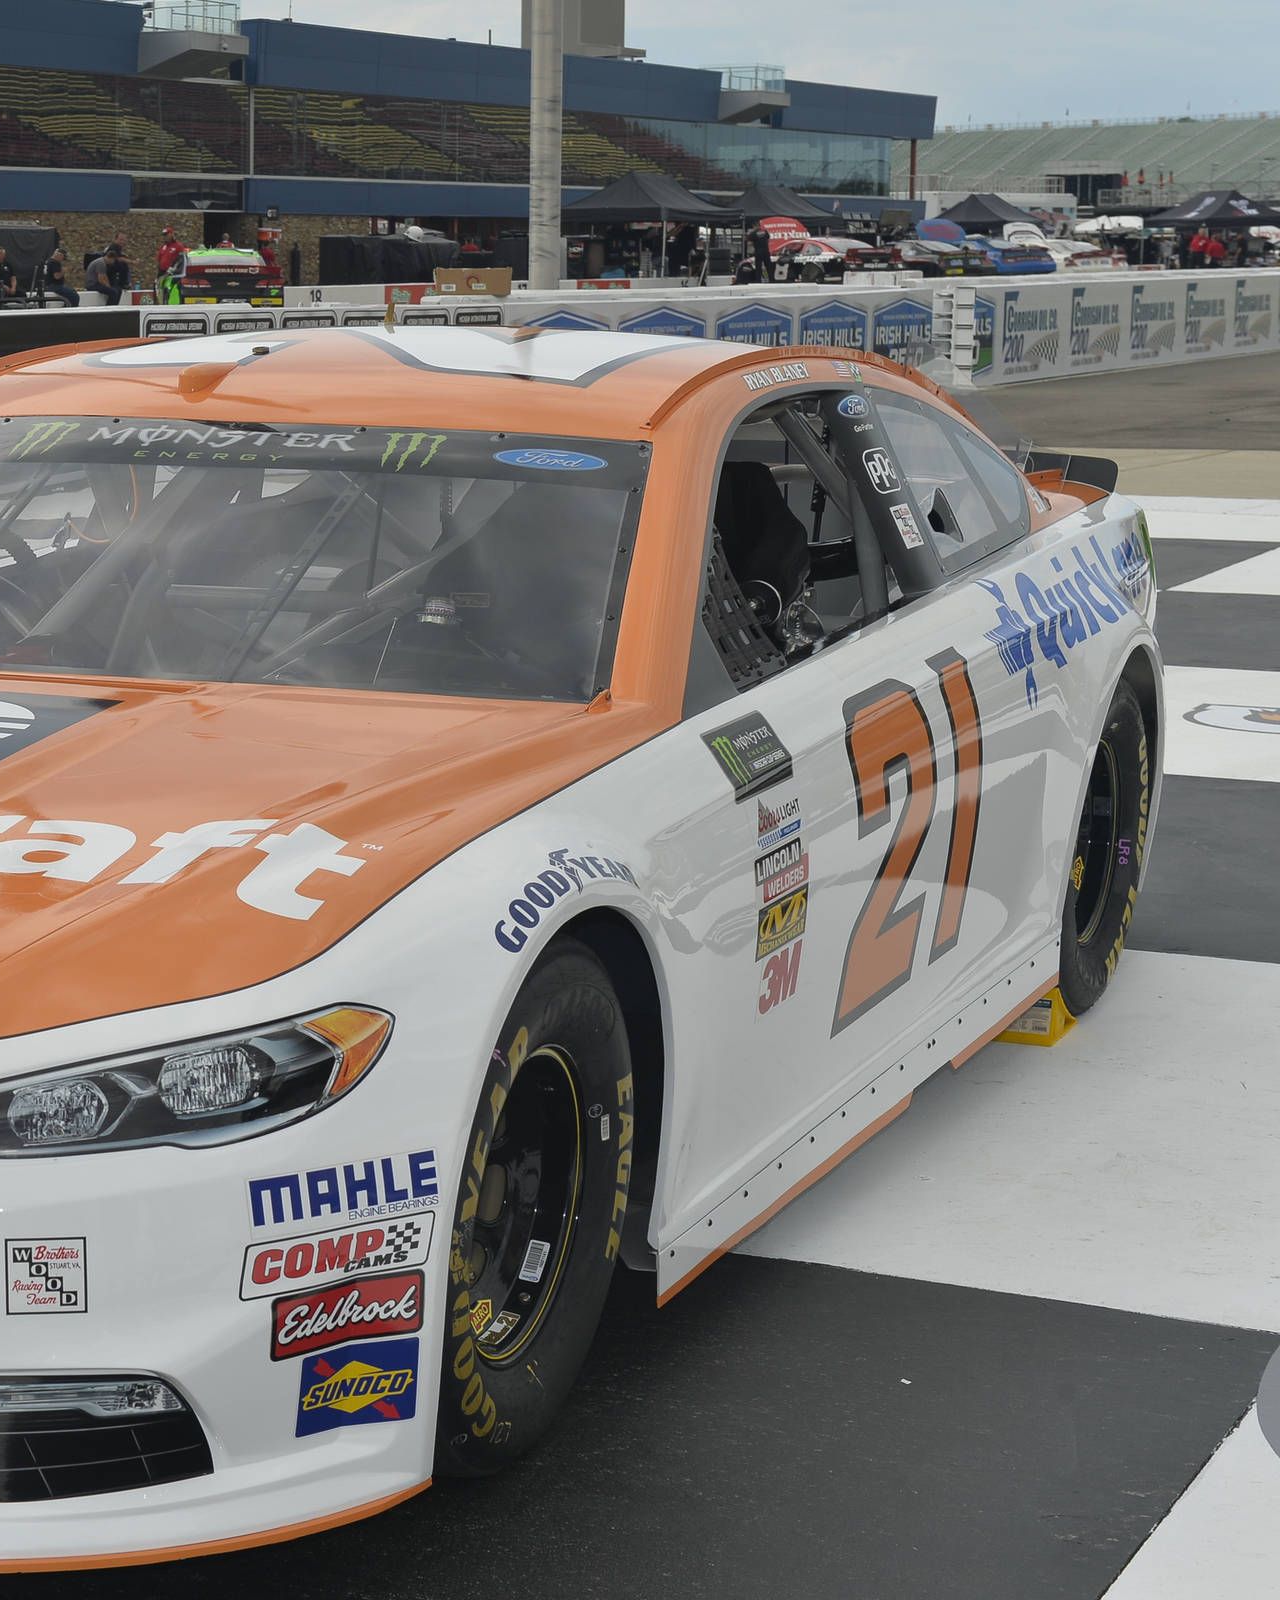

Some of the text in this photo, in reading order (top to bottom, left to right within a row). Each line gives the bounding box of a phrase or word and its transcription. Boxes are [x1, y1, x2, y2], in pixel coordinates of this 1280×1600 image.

[834, 327, 863, 346] HILLS
[876, 323, 902, 345] IRISH
[743, 361, 810, 391] RYAN BLANEY
[87, 424, 356, 452] MONSTER
[133, 450, 284, 462] ENERGY
[732, 725, 773, 751] MONSTER
[830, 646, 983, 1040] 21
[756, 842, 801, 883] LINCOLN
[767, 865, 805, 897] WELDERS
[495, 848, 640, 953] GOODYEAR
[757, 939, 803, 1016] 3M
[605, 1072, 634, 1260] EAGLE
[249, 1149, 439, 1227] MAHLE
[348, 1195, 439, 1220] ENGINE BEARINGS
[34, 1245, 79, 1260] Brothers
[252, 1229, 385, 1285] COMP
[344, 1250, 408, 1273] CAMS
[12, 1280, 43, 1293] Racing
[27, 1294, 57, 1305] Team
[277, 1285, 418, 1346] Edelbrock
[306, 1370, 412, 1410] SUNOCO
